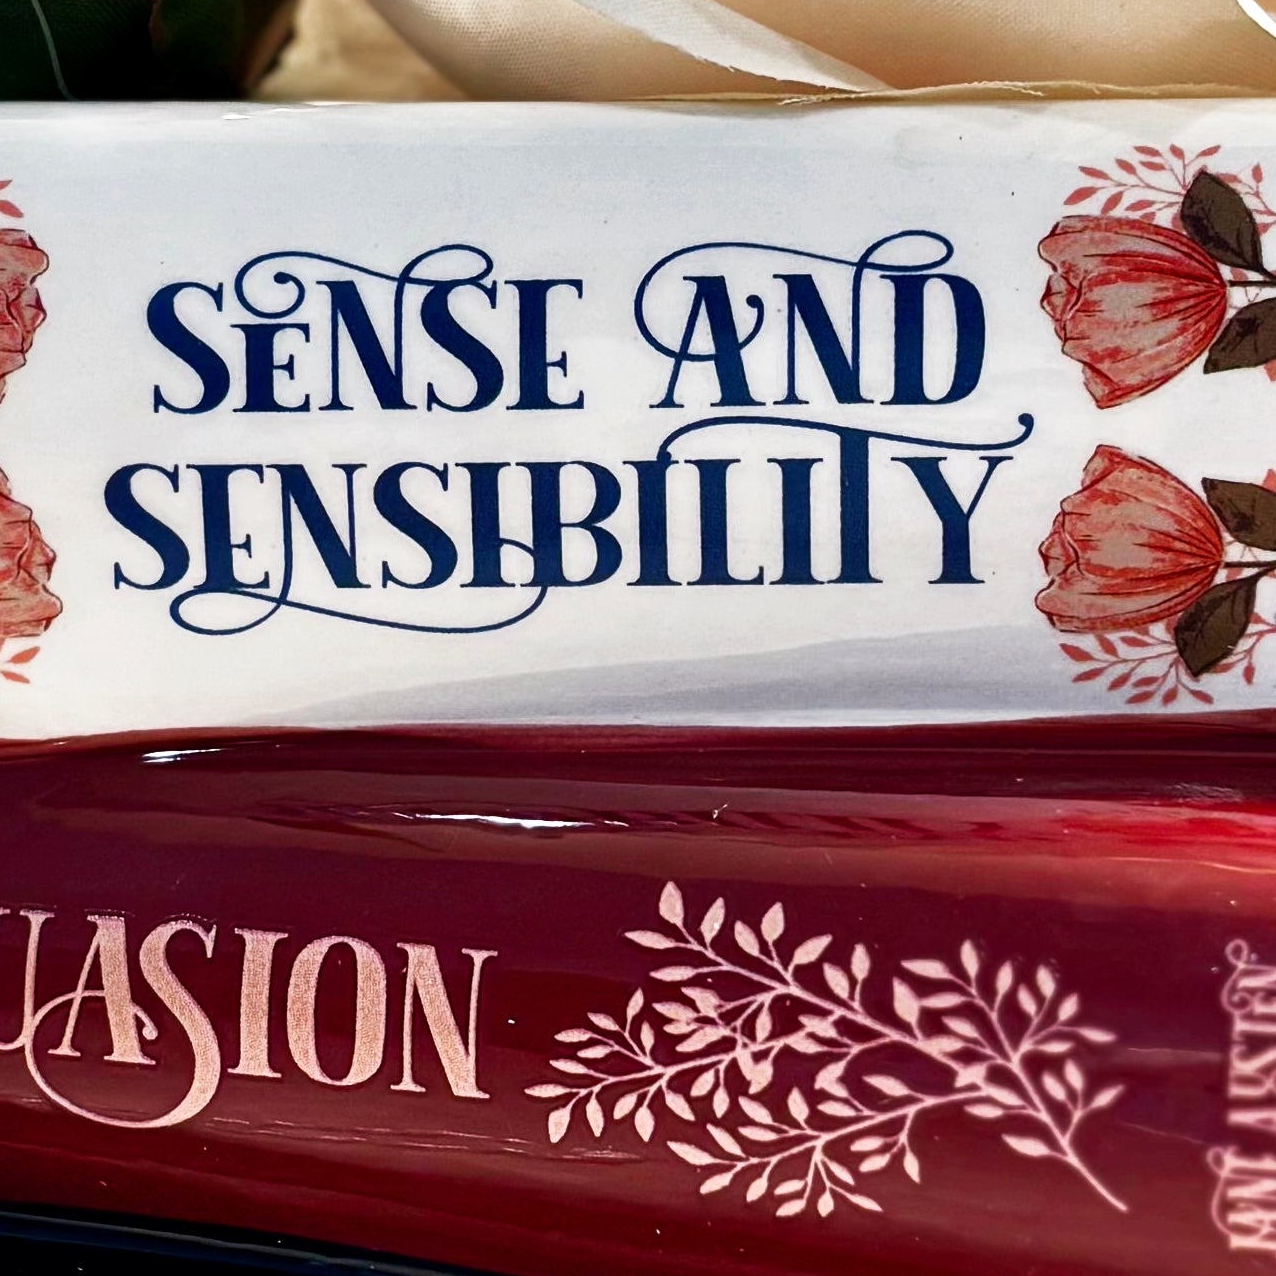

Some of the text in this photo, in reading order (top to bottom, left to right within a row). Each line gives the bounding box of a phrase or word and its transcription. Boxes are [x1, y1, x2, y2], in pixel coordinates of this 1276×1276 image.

[147, 230, 986, 412] SENSE AND
[103, 414, 1034, 635] SENSIBILITY
